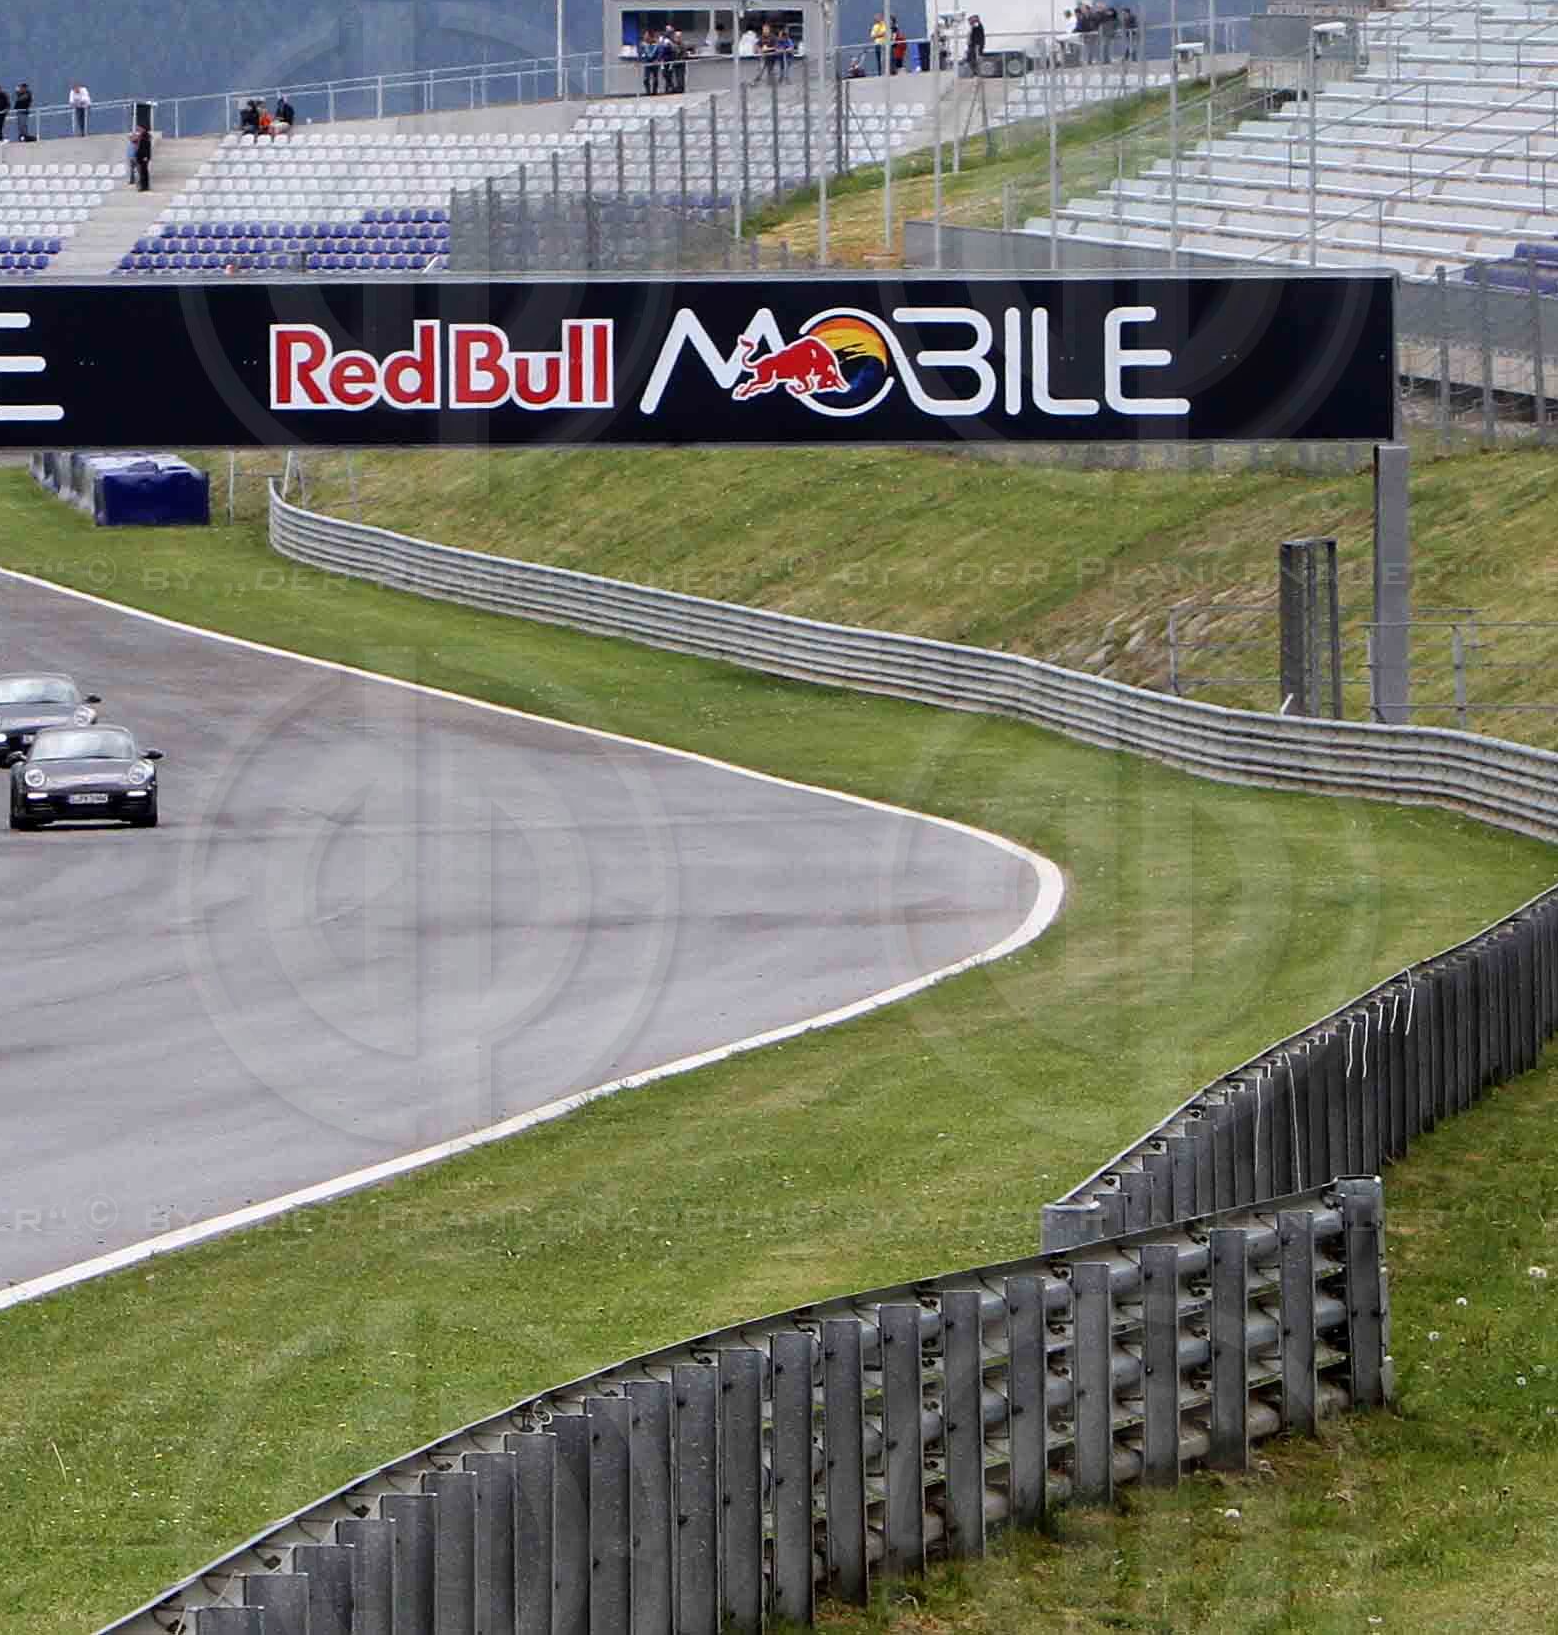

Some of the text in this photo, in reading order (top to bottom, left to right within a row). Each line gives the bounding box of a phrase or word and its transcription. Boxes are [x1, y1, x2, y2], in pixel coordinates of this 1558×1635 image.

[269, 306, 1191, 417] Red Bull MOBILE
